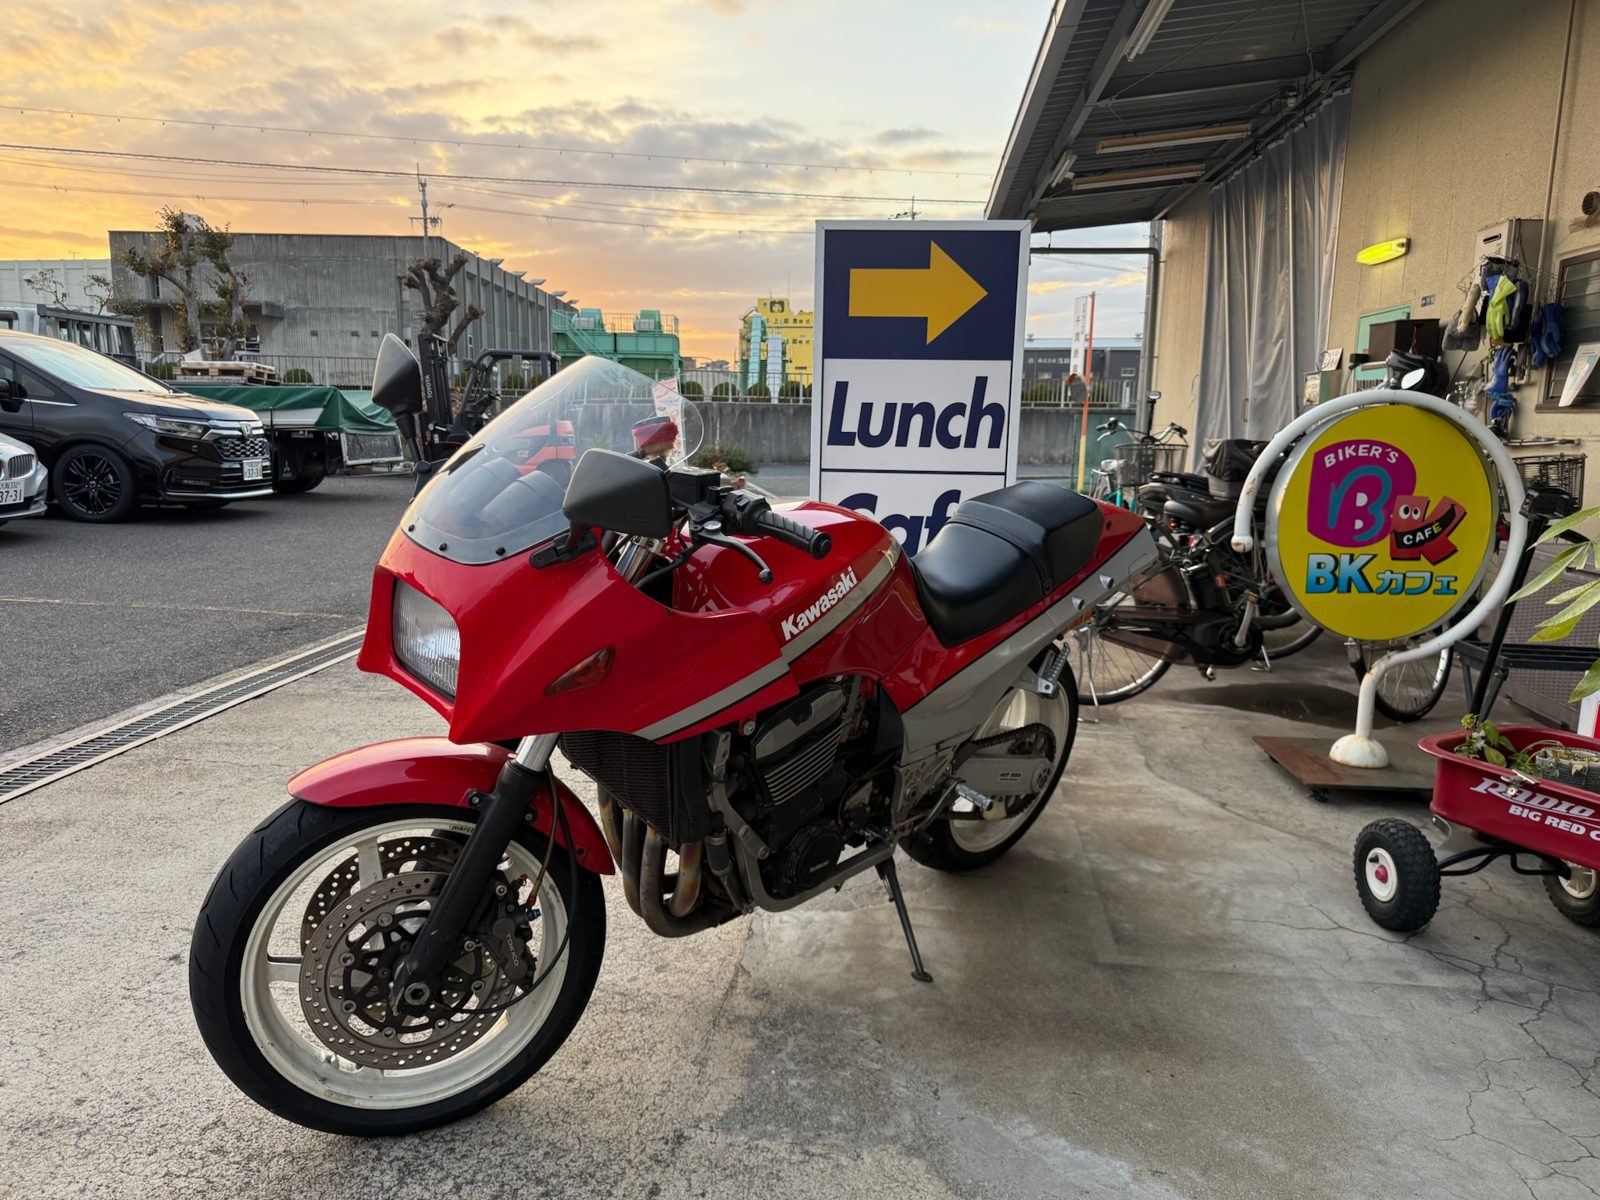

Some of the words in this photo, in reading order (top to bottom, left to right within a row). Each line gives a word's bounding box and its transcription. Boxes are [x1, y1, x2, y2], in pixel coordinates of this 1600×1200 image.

[827, 376, 1005, 449] Lunch
[1324, 444, 1399, 468] BIKER'S
[781, 566, 858, 641] Kawasaki
[1508, 805, 1543, 822] BIG
[1544, 816, 1586, 835] RED
[505, 931, 520, 967] TOKICO
